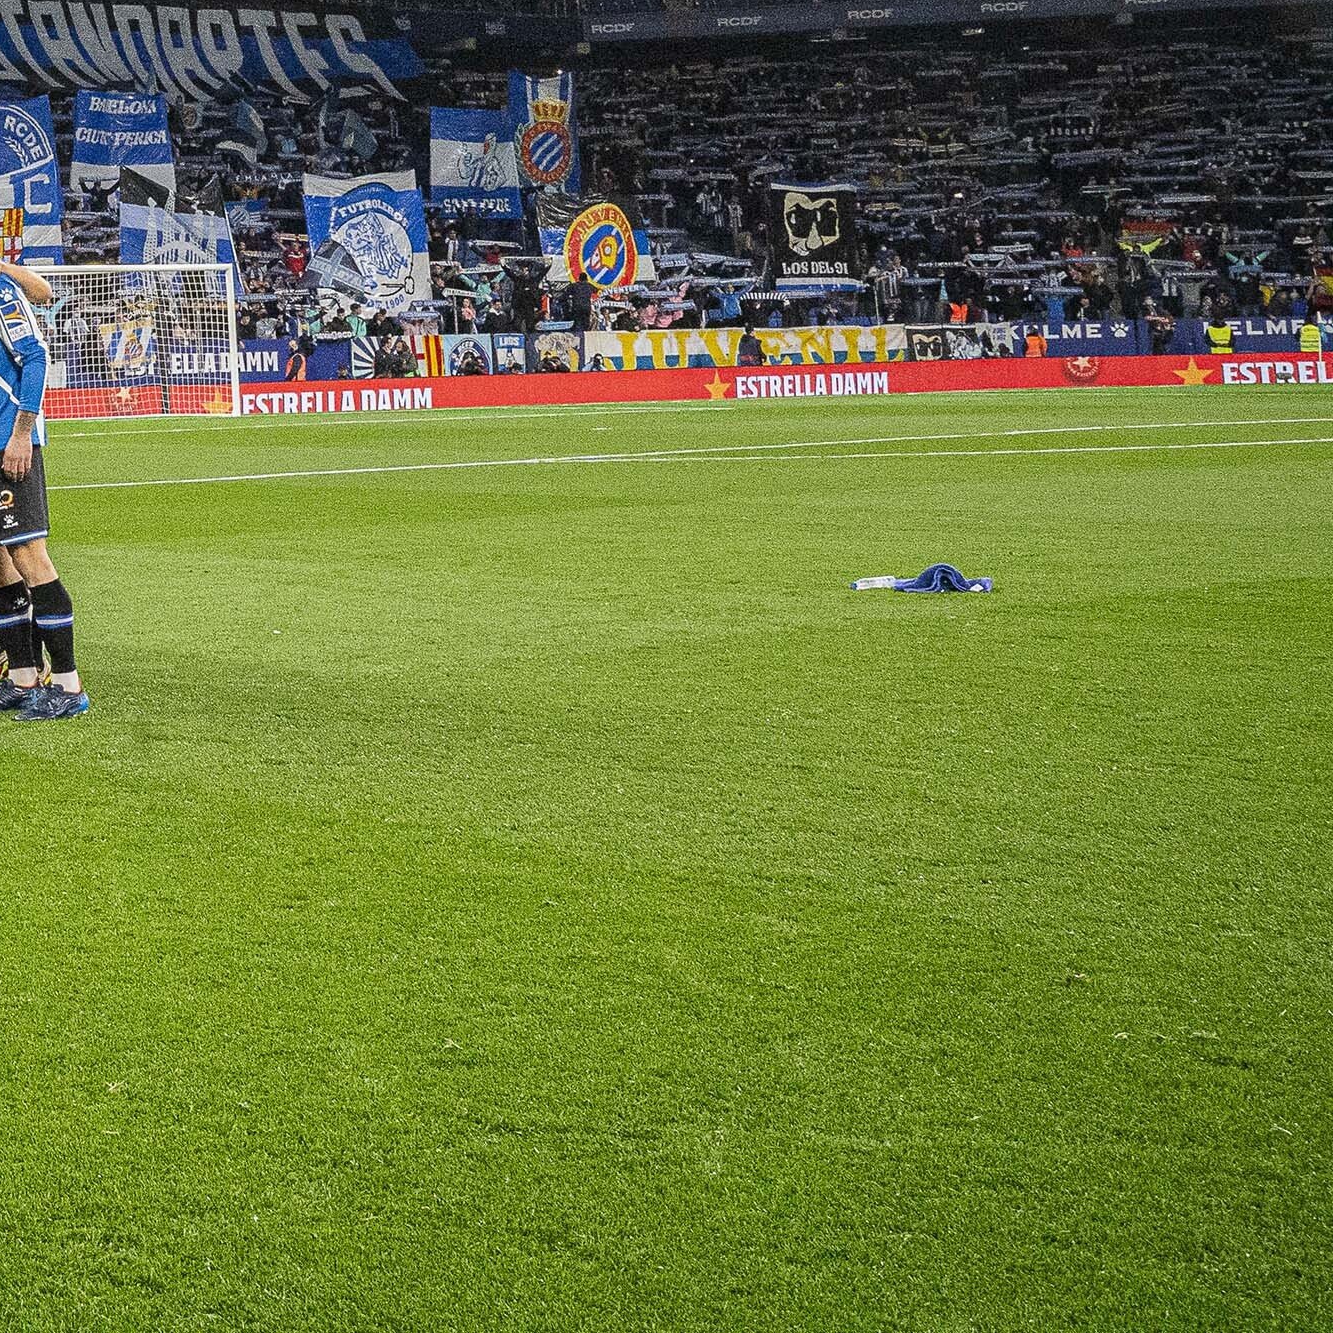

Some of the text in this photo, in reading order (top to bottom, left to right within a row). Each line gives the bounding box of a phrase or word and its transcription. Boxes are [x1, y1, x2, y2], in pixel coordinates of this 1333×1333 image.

[3, 114, 44, 161] RCDE
[782, 261, 809, 276] LOS
[810, 261, 834, 276] DEL
[1203, 319, 1306, 336] ELME
[735, 370, 889, 399] ESTRELLA DAMM
[242, 386, 433, 415] ESTRELLA DAMM
